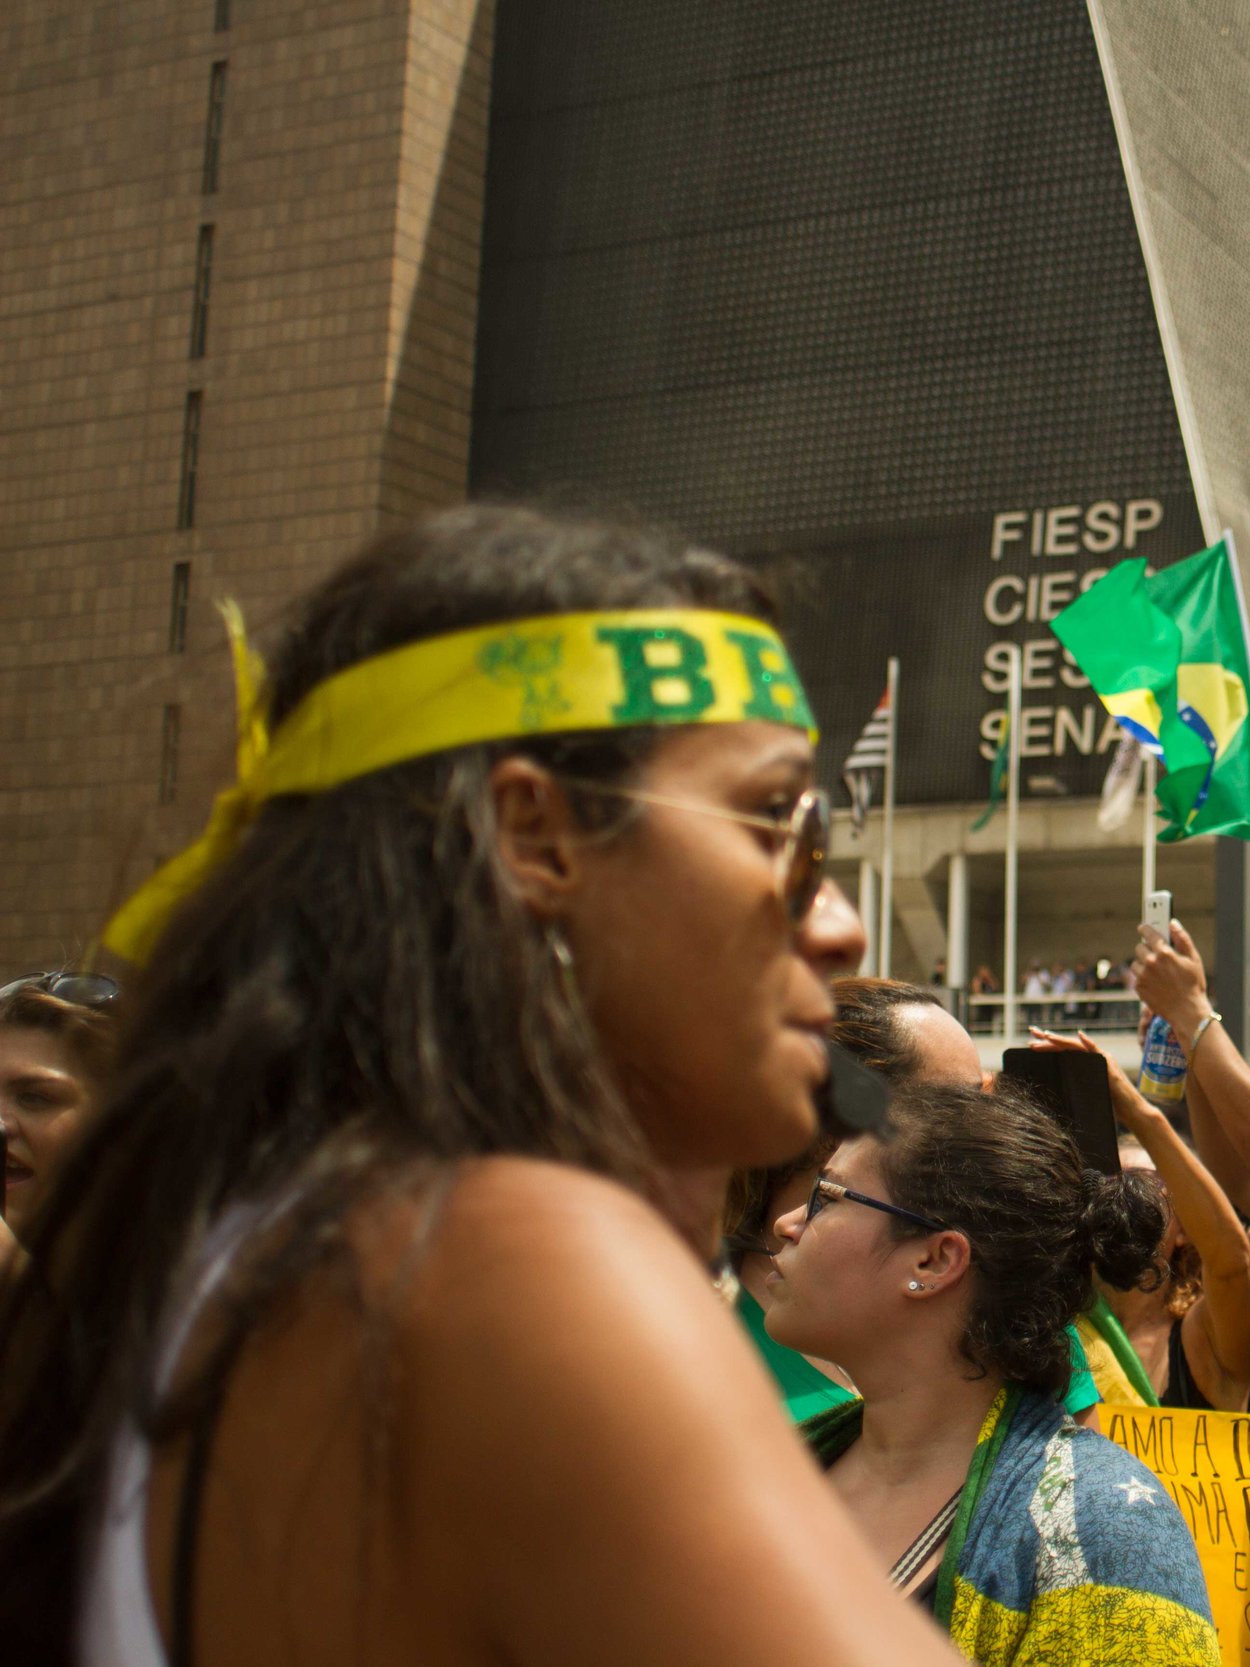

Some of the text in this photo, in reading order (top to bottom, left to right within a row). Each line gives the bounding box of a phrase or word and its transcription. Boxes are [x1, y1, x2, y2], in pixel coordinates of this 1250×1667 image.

[990, 499, 1164, 561] FIESP
[983, 567, 1157, 627] CIE
[1108, 1414, 1179, 1477] AMO
[1190, 1414, 1220, 1479] A
[1234, 1552, 1249, 1592] E
